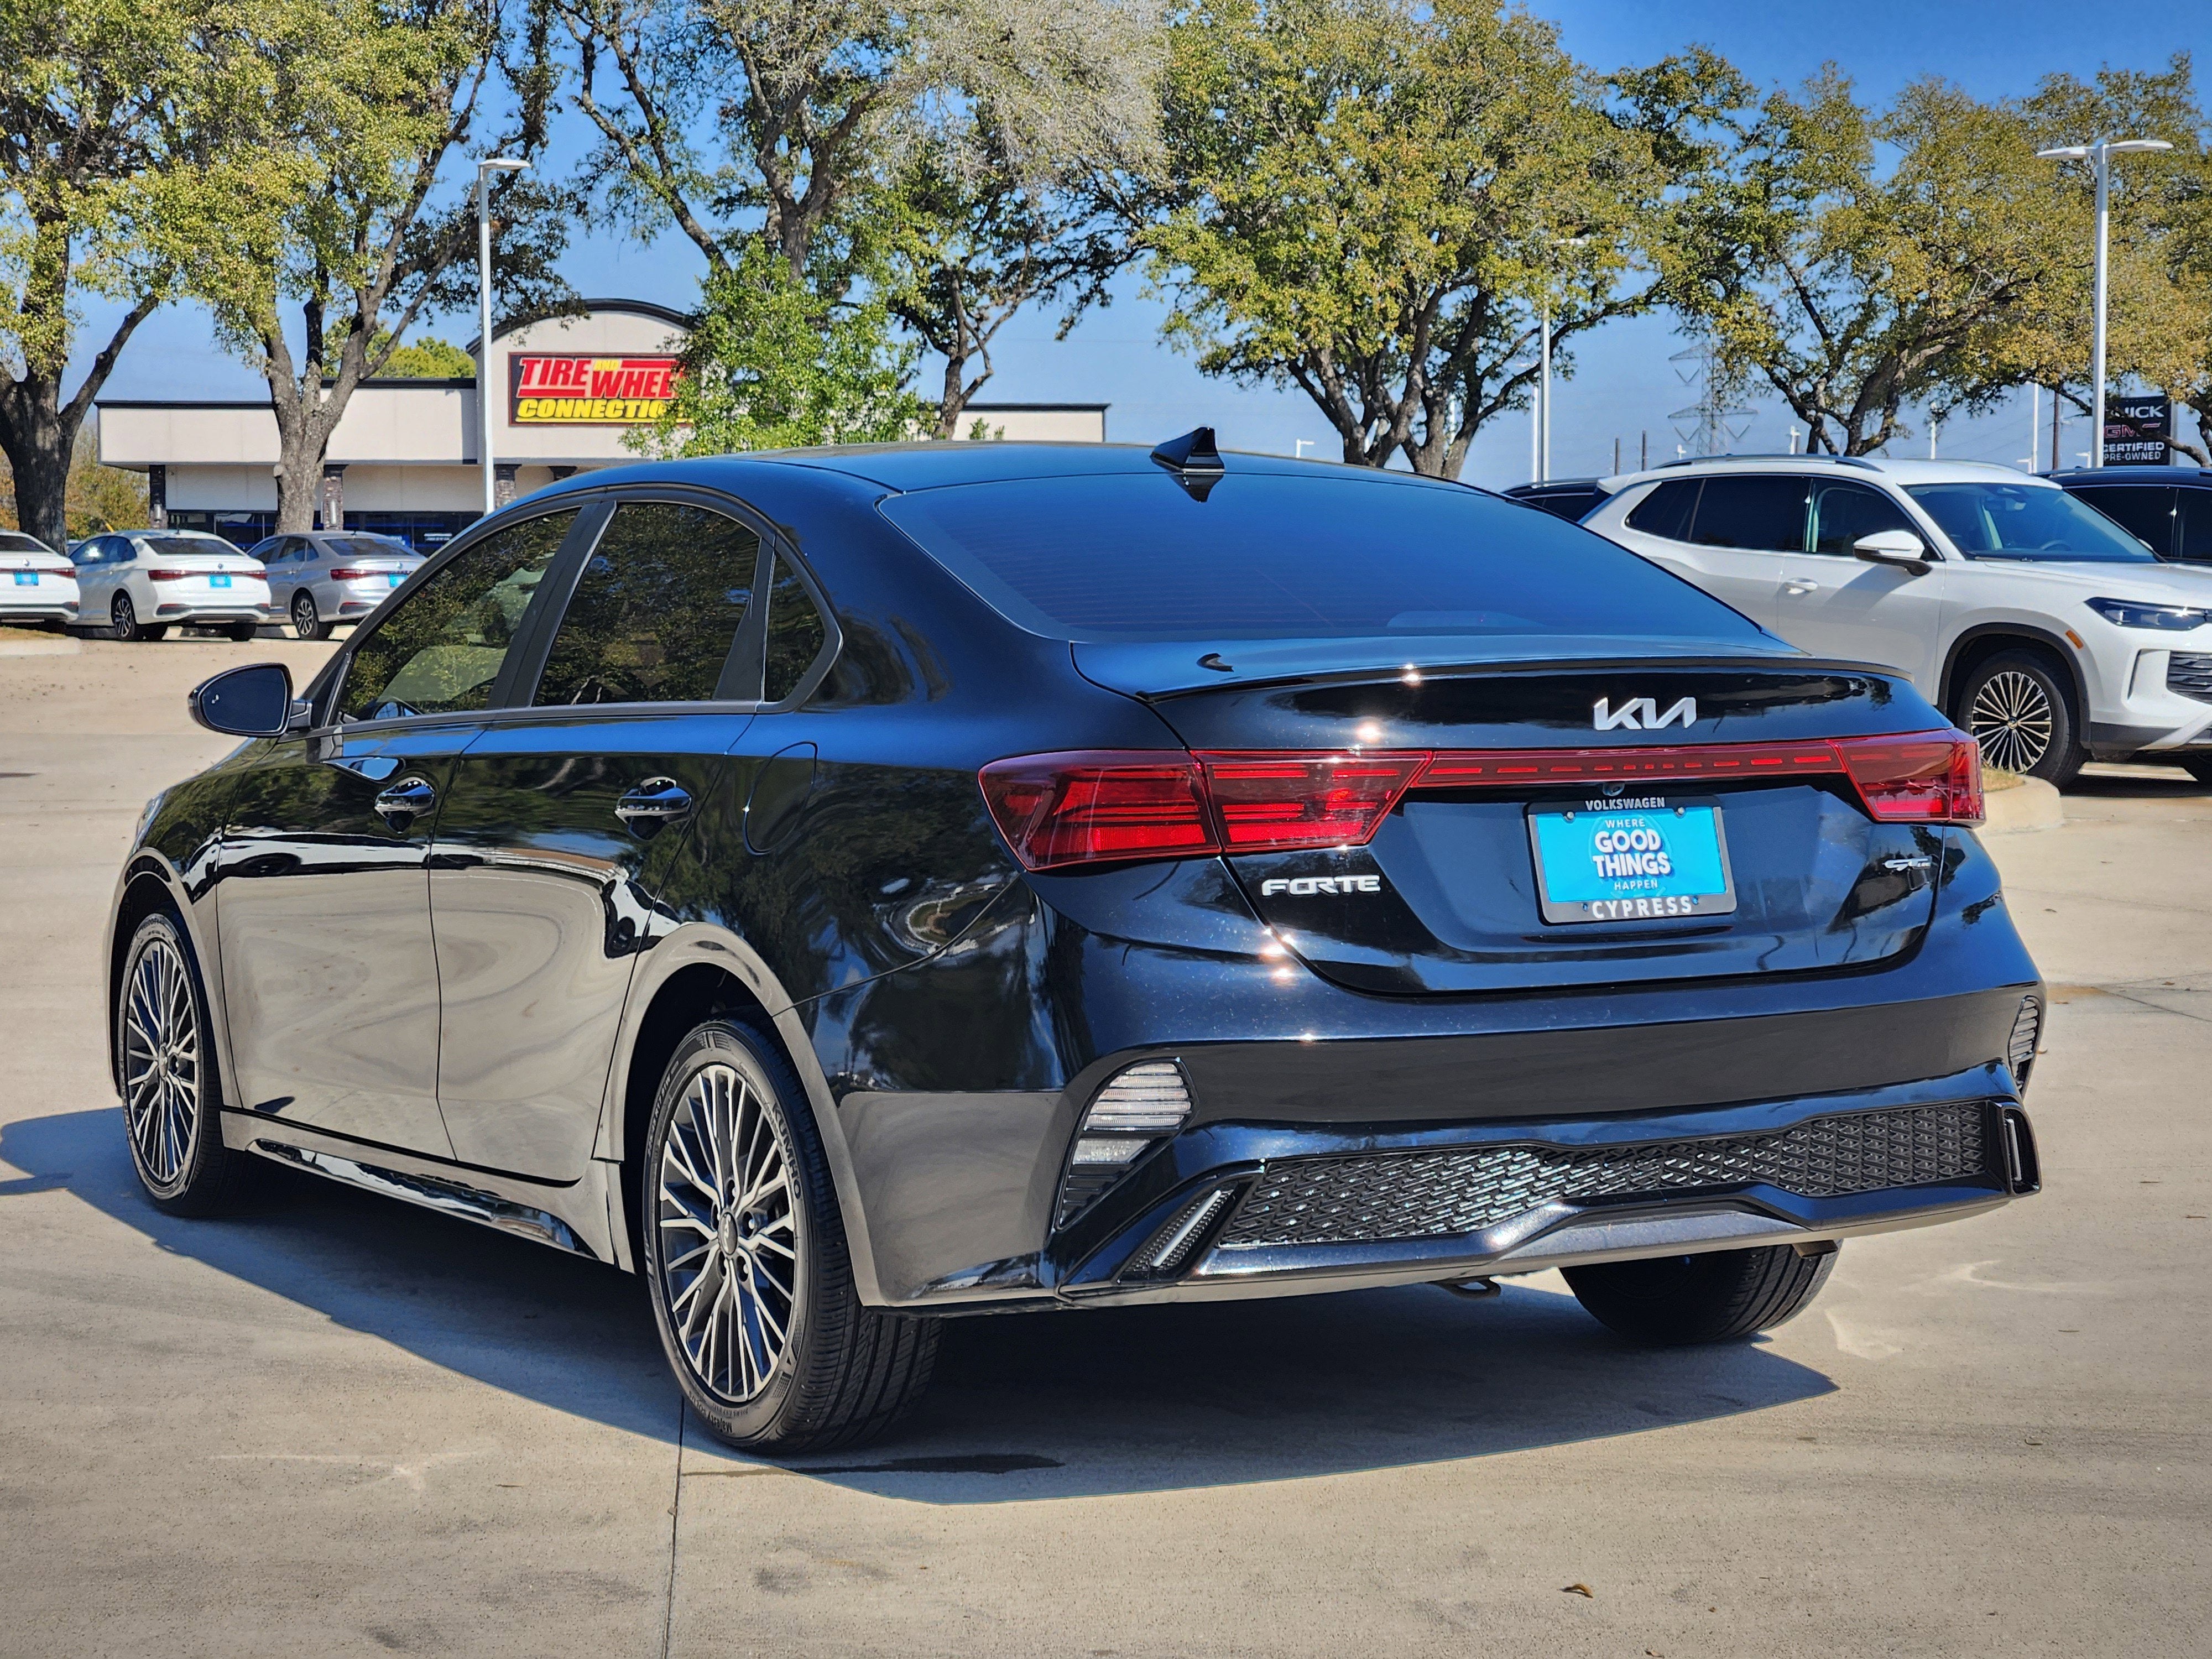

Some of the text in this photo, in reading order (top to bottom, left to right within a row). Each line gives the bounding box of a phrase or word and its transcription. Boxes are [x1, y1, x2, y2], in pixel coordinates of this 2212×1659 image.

[520, 359, 685, 398] TIRE AND WHEE
[517, 399, 685, 419] CONNECTIO
[2103, 441, 2165, 453] CERTIFIED
[2103, 451, 2161, 461] PRE-OWNED
[1594, 697, 1697, 731] KIA
[1585, 797, 1666, 811] VOLKSWAGEN
[1605, 818, 1646, 828] WHERE
[1594, 828, 1662, 853] GOOD
[1592, 852, 1671, 878] THINGS
[1261, 875, 1381, 896] FORTE
[1614, 880, 1658, 891] HAPPEN
[1592, 896, 1692, 919] CYPRESS
[772, 1103, 802, 1199] KUMHO
[707, 1411, 733, 1433] Majesty
